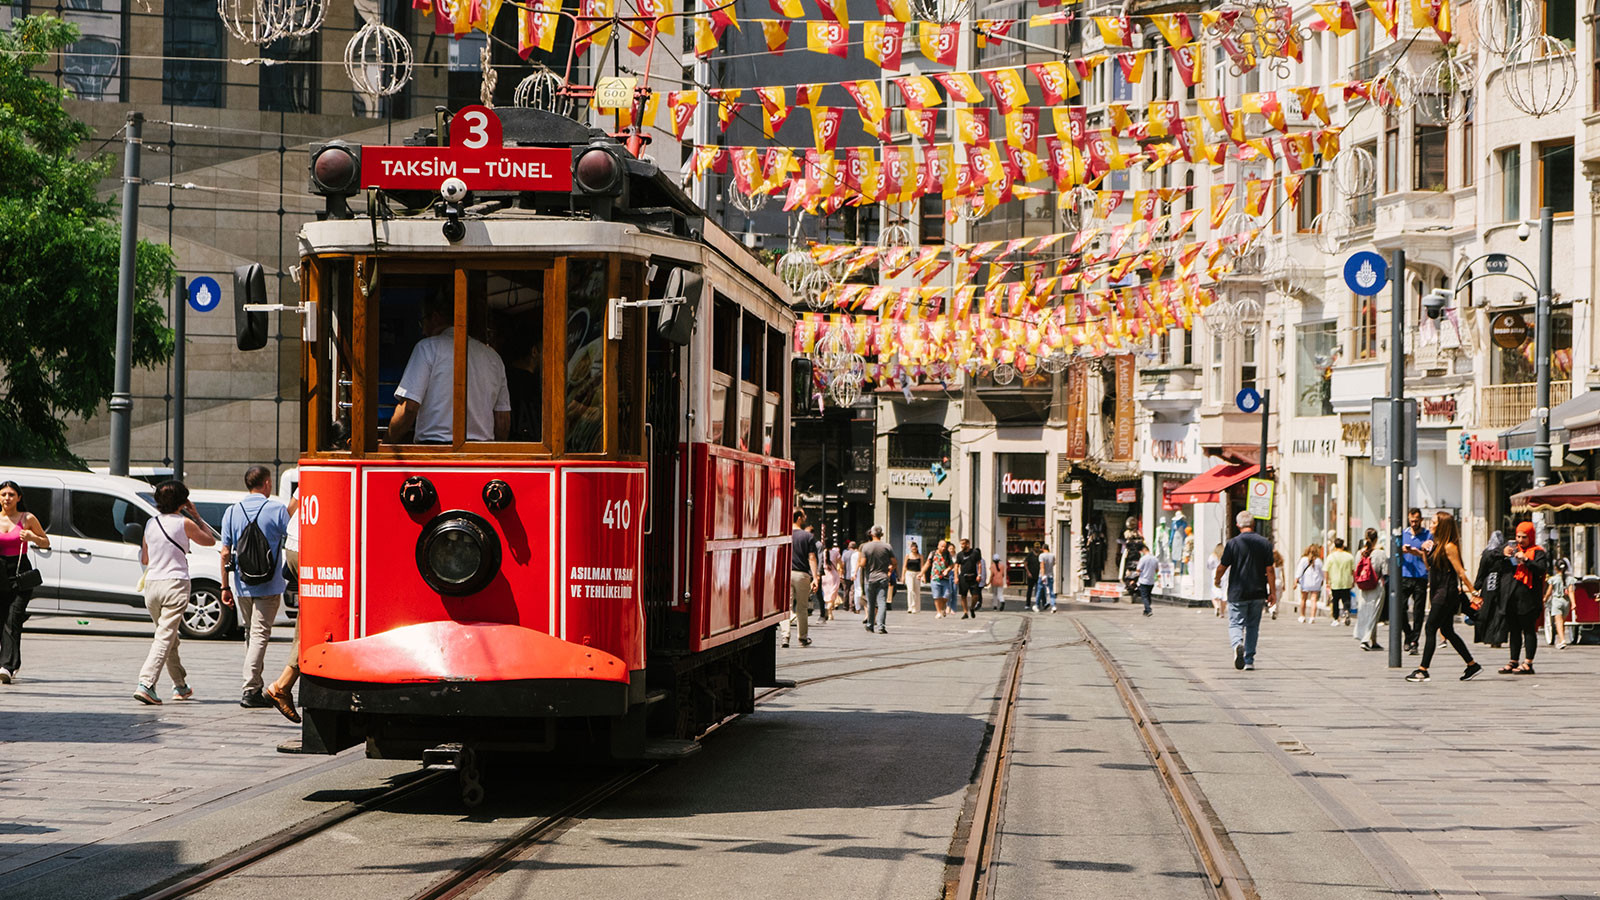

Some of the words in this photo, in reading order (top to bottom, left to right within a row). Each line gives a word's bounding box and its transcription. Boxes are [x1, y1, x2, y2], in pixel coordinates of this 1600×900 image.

[817, 26, 839, 41] 23
[873, 34, 893, 55] 23
[929, 34, 949, 50] 23
[603, 90, 626, 98] 600
[600, 99, 626, 107] VOLT
[1157, 104, 1174, 119] 23
[462, 111, 488, 149] 3
[819, 120, 832, 139] 23
[966, 121, 982, 136] 23
[1014, 121, 1031, 139] 23
[381, 156, 457, 177] TAKSİM
[485, 157, 552, 179] TÜNEL
[1002, 472, 1046, 495] flormar
[602, 499, 631, 530] 410
[317, 567, 344, 580] YASAK
[570, 567, 612, 580] ASILMAK
[614, 568, 633, 581] YASAK
[570, 584, 582, 598] VE
[585, 583, 633, 599] TEHLİKELİDİR
